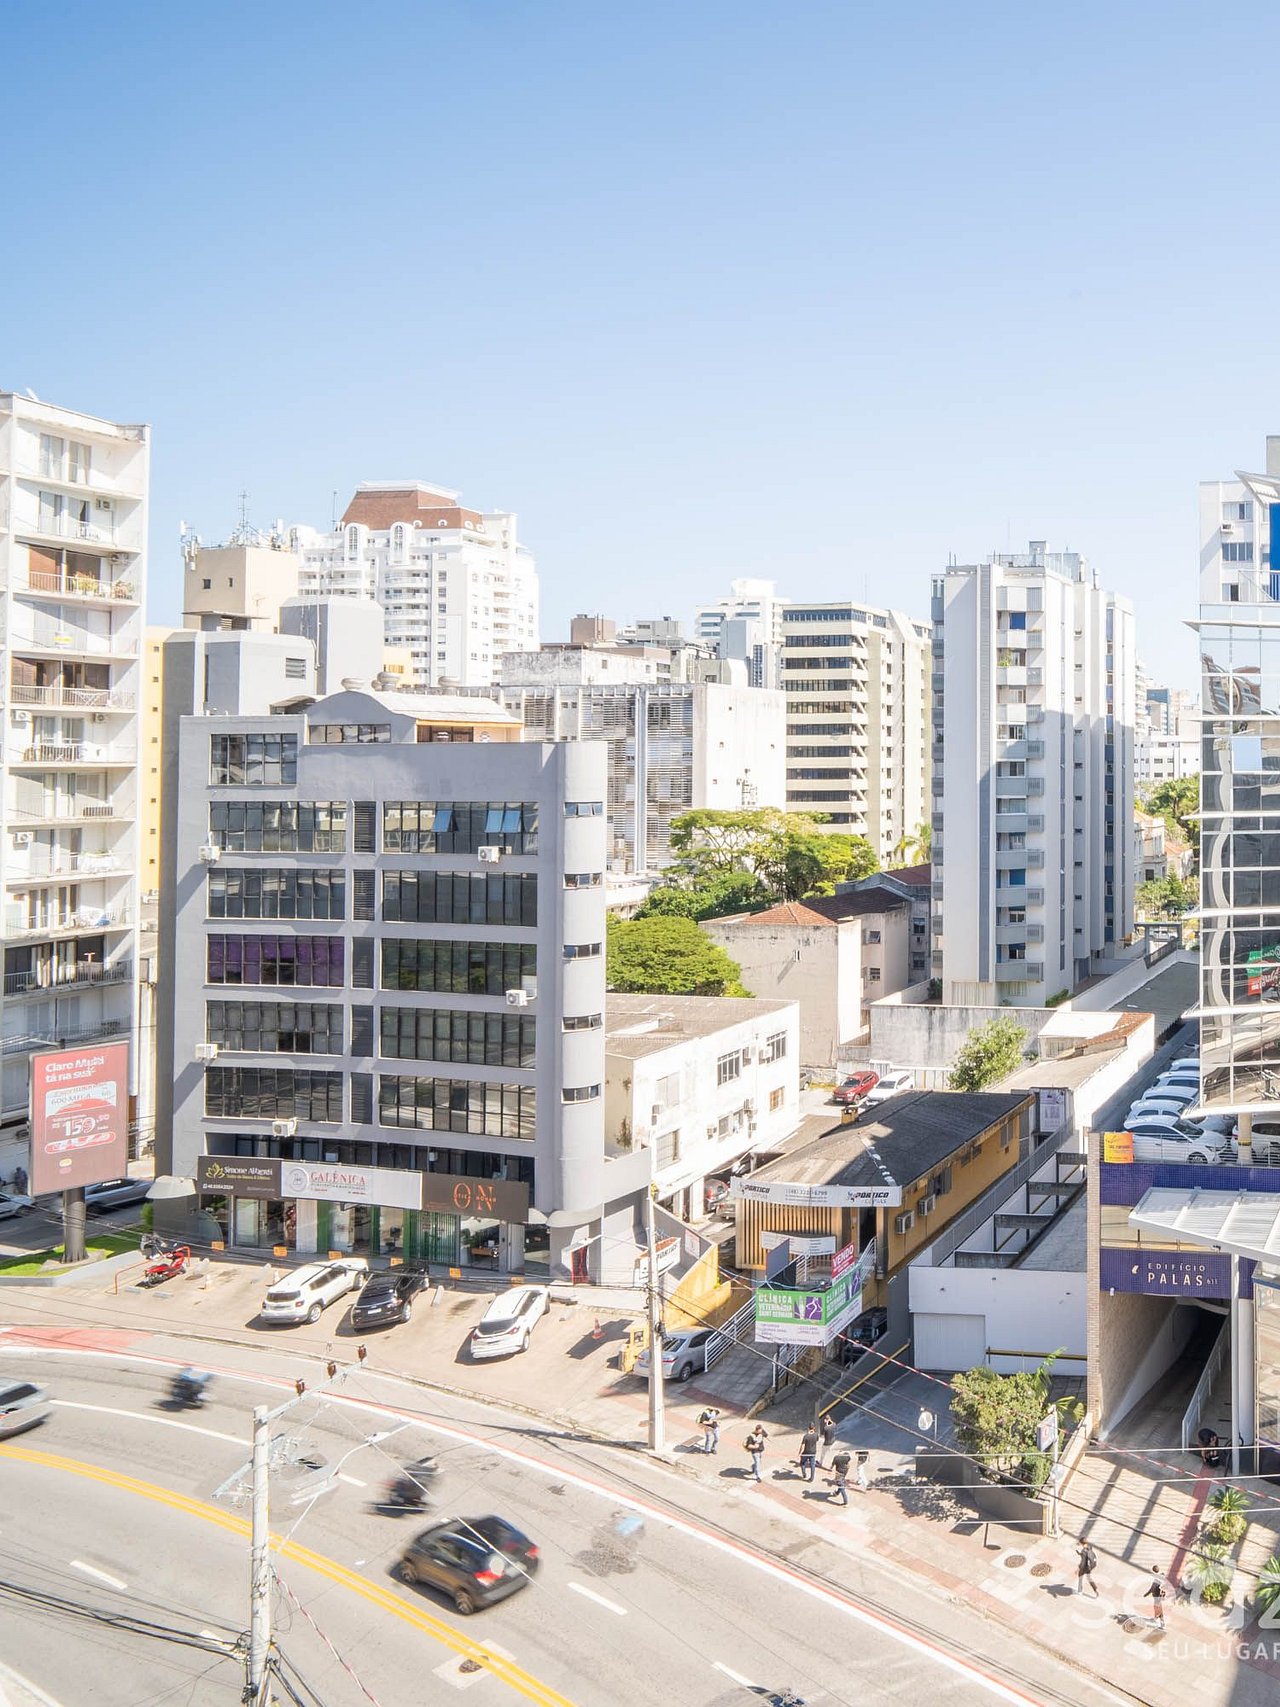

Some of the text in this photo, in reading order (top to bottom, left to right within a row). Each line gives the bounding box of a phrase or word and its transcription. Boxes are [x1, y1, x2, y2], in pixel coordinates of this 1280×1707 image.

[45, 1061, 74, 1073] Claro
[224, 1165, 247, 1175] Simone
[310, 1170, 366, 1185] GALÊNICA
[832, 1244, 855, 1267] VENDO
[1147, 1262, 1206, 1272] EDIFÍCIO
[1147, 1272, 1203, 1287] PALAS
